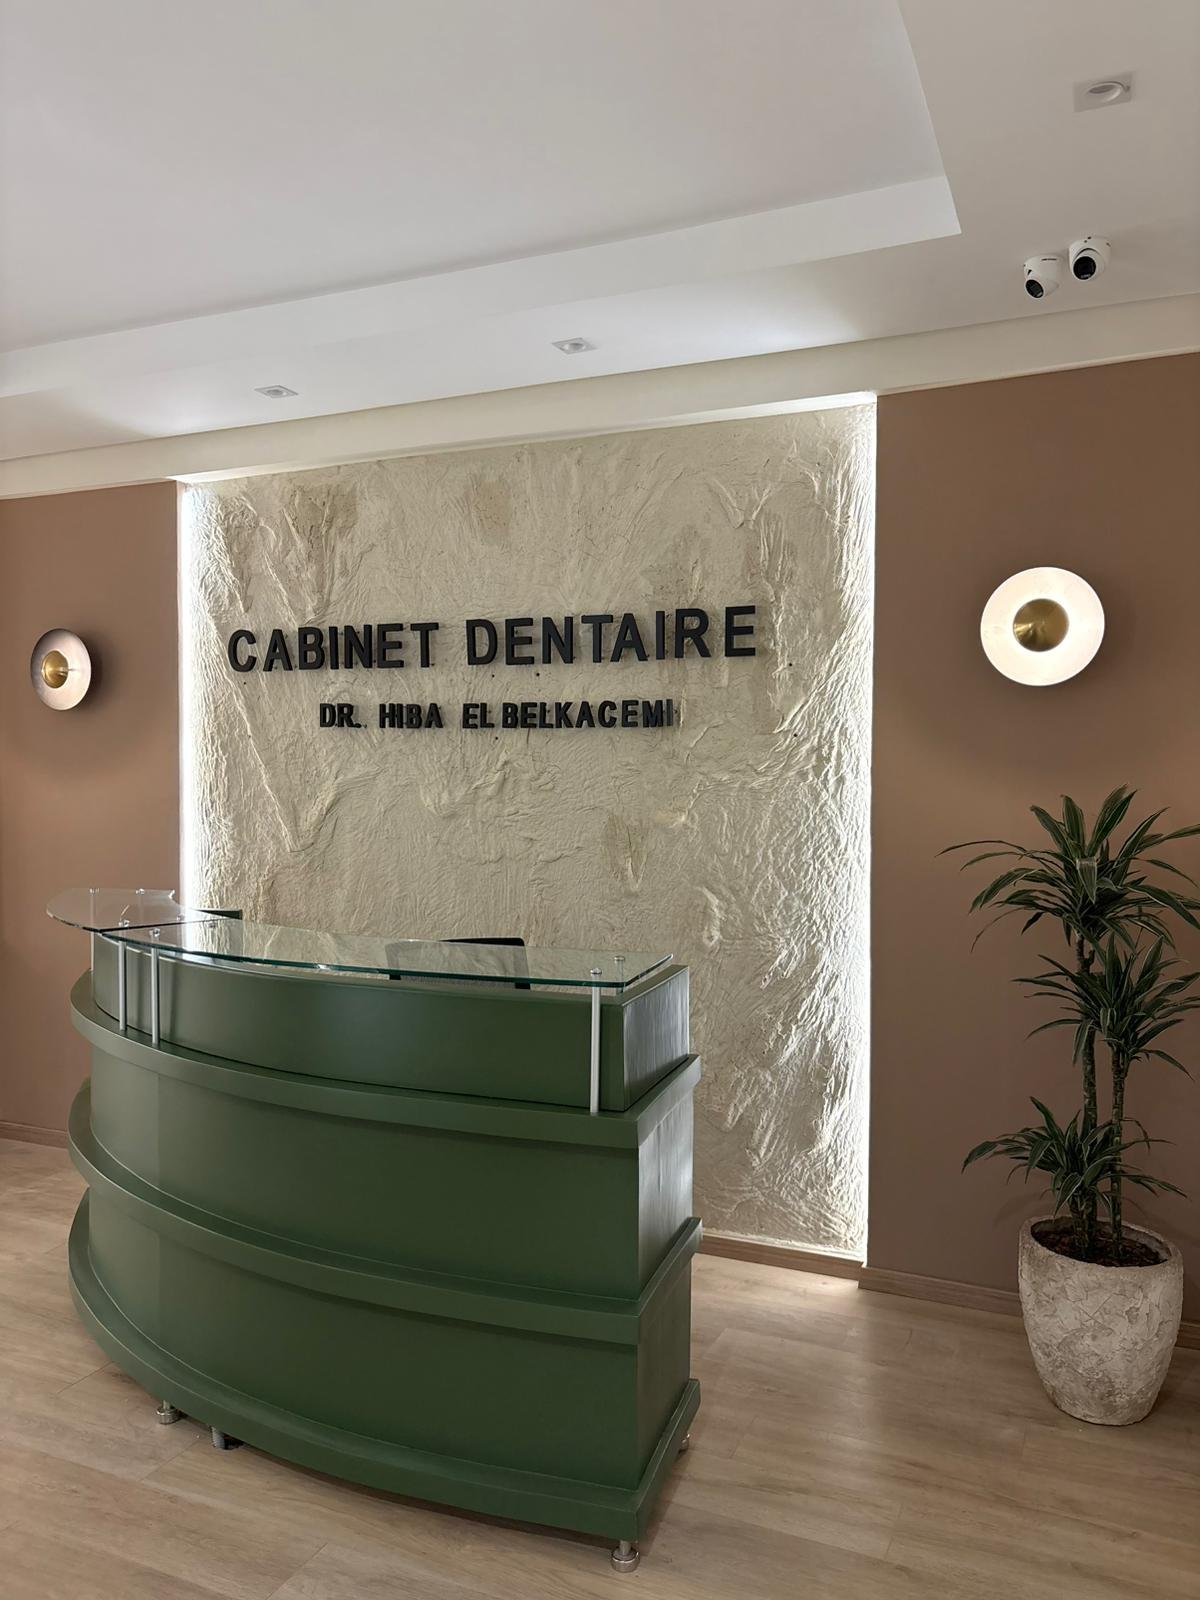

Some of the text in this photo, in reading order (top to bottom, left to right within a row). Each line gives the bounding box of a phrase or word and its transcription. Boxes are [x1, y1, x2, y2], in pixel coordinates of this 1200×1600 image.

[227, 605, 757, 673] CABINET DENTAIRE
[319, 703, 362, 728] DR.
[378, 703, 444, 729] HIBA
